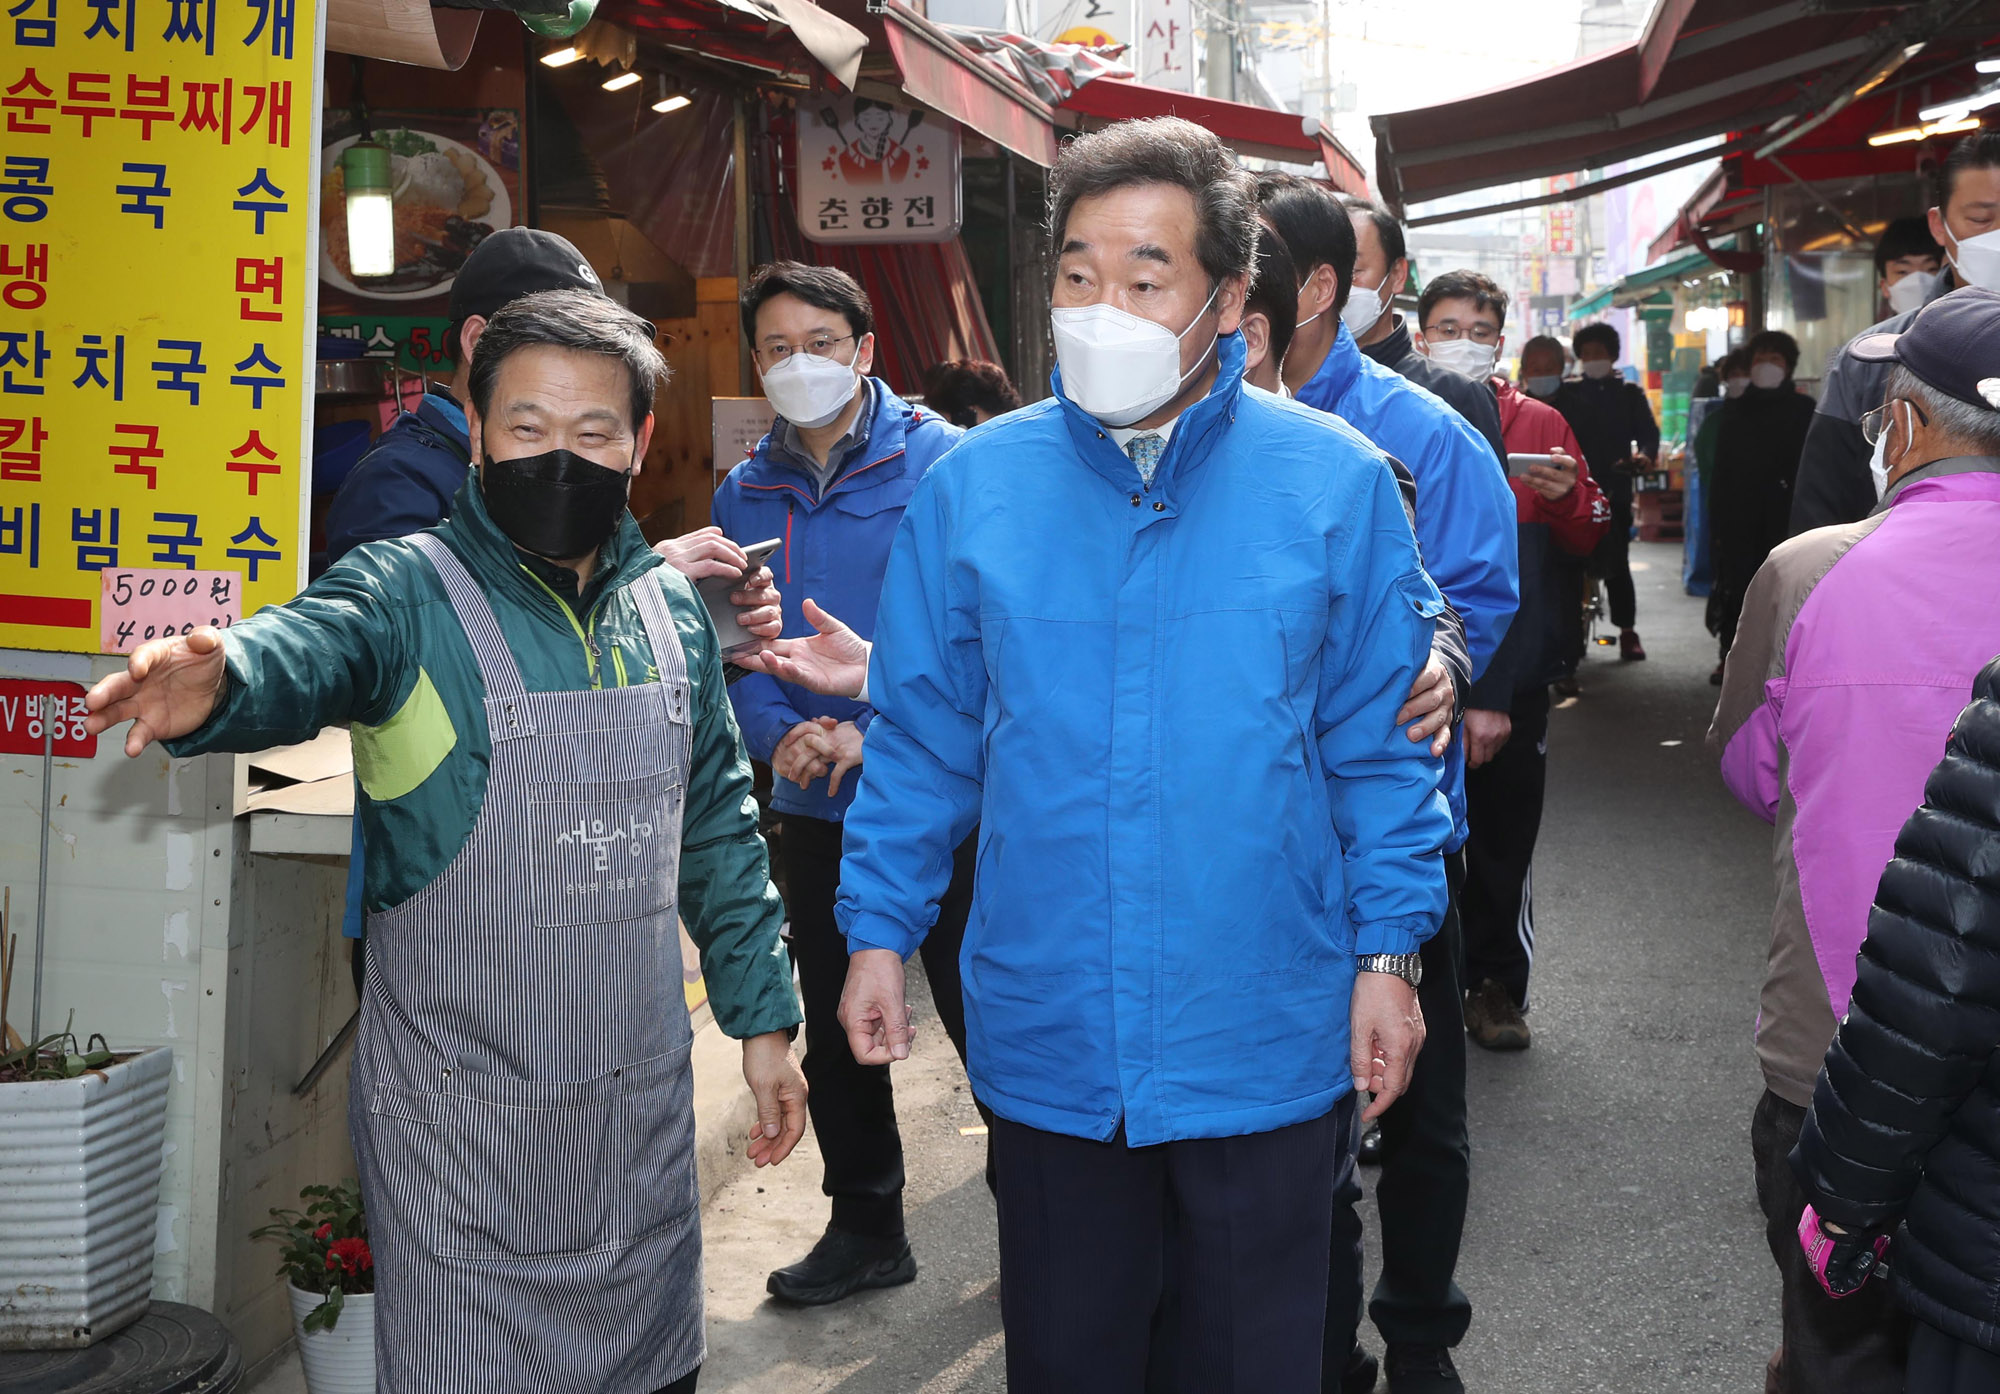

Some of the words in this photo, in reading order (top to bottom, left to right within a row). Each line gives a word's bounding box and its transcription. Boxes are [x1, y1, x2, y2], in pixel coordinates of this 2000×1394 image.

[7, 0, 295, 59] 김치찌개
[2, 68, 292, 148] 순두부찌개
[0, 156, 288, 234] 콩국수
[818, 196, 935, 230] 춘향전
[578, 264, 597, 284] G
[0, 331, 286, 409] 잔치국수
[410, 327, 450, 363] 5,
[0, 417, 281, 495] 칼국수
[0, 503, 281, 582] 비빔국수
